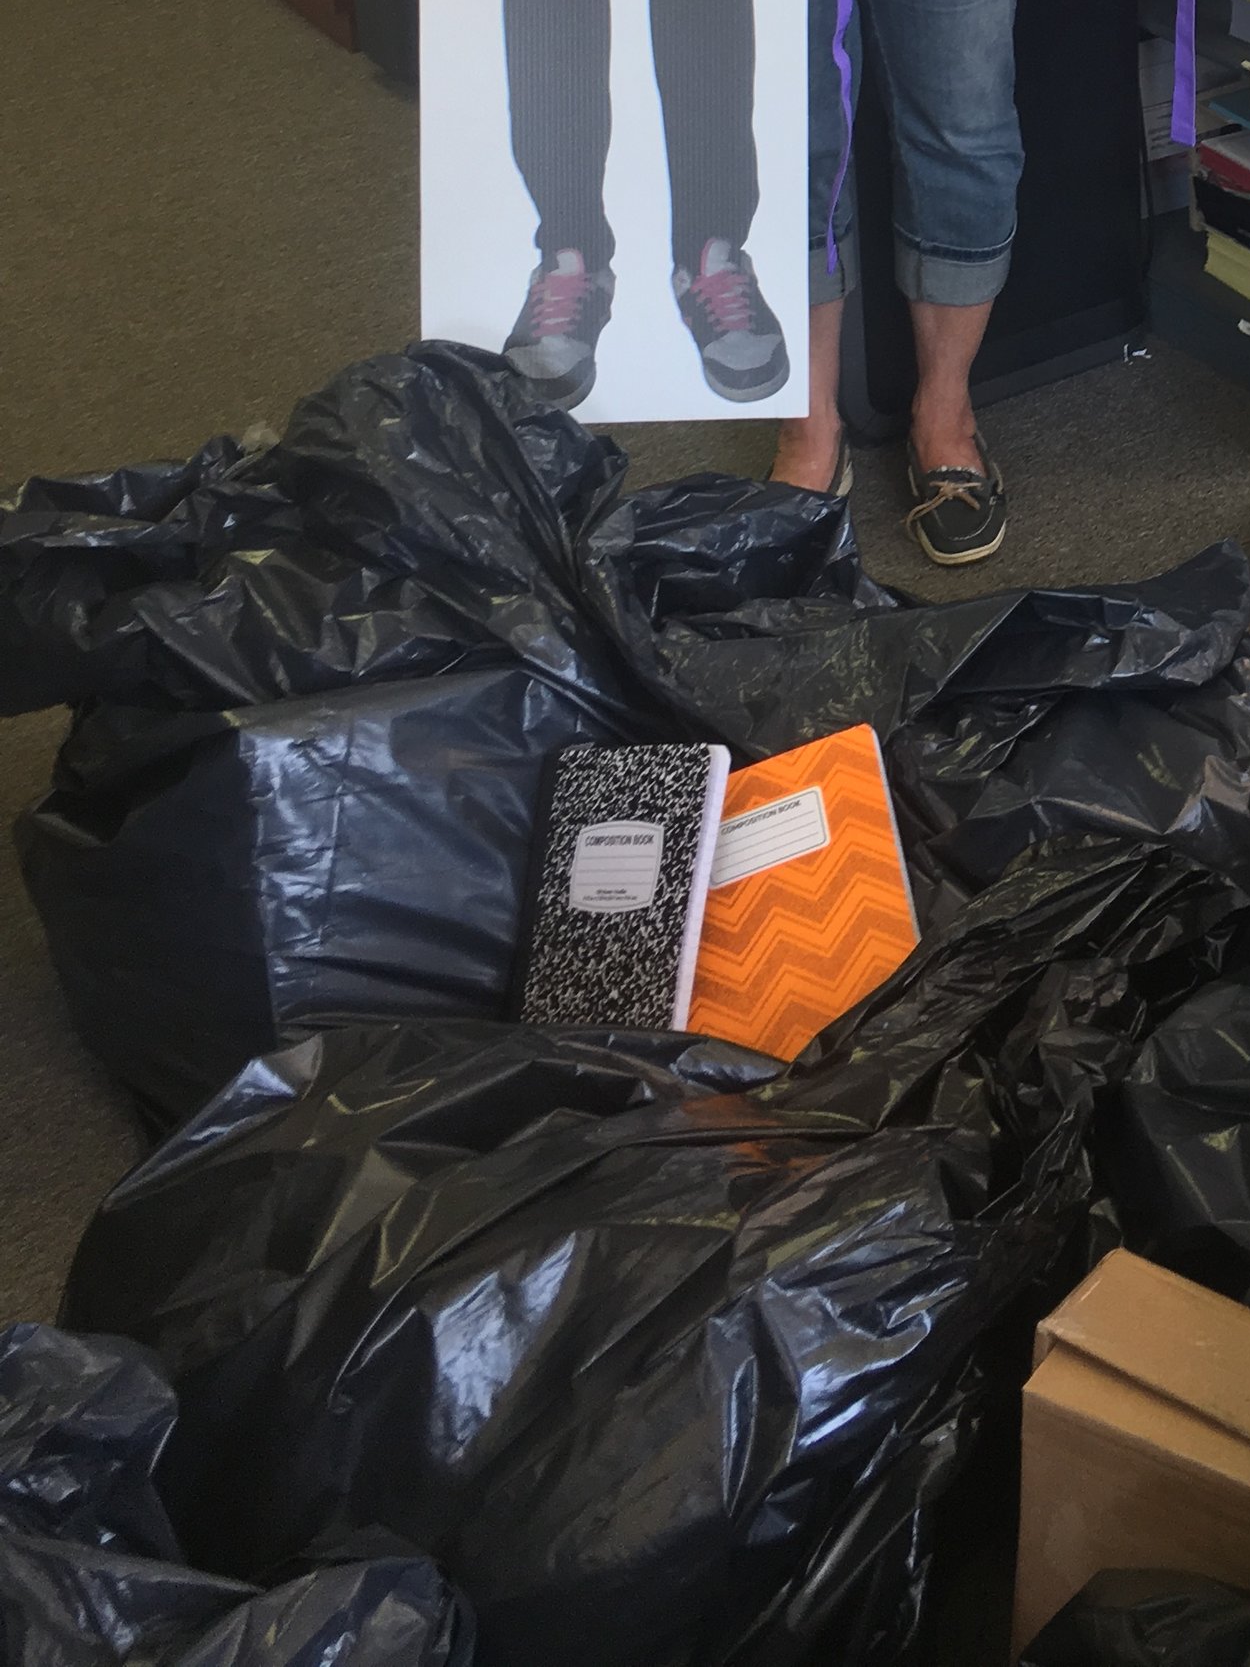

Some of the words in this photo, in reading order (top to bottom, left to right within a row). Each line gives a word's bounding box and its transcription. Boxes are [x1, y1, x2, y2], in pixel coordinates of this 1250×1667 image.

[720, 809, 777, 836] COMPOSITION
[778, 800, 801, 814] BOOK
[585, 835, 633, 846] COMPOSITION
[633, 834, 655, 845] BOOK
